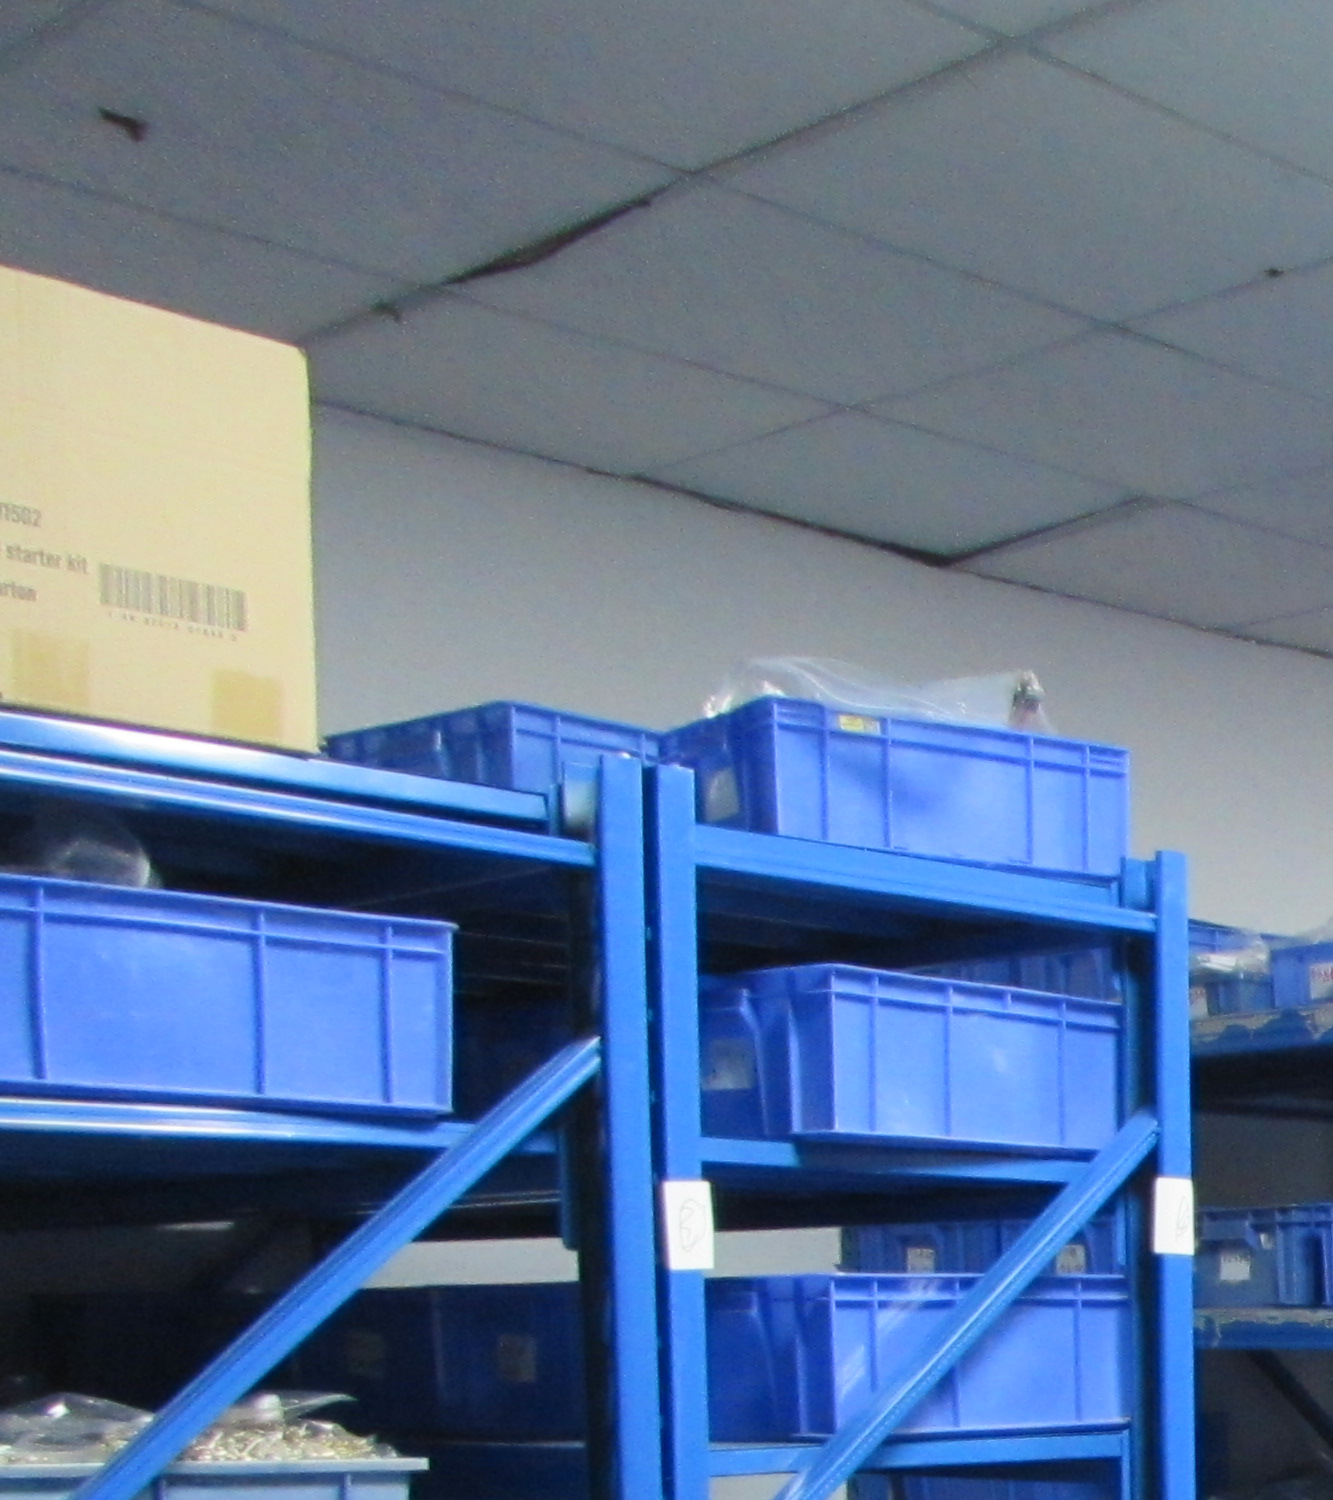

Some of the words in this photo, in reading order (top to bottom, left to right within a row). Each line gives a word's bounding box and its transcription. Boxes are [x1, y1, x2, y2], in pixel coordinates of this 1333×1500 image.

[0, 502, 42, 527] 1502
[6, 545, 61, 570] starter
[66, 551, 89, 576] kit
